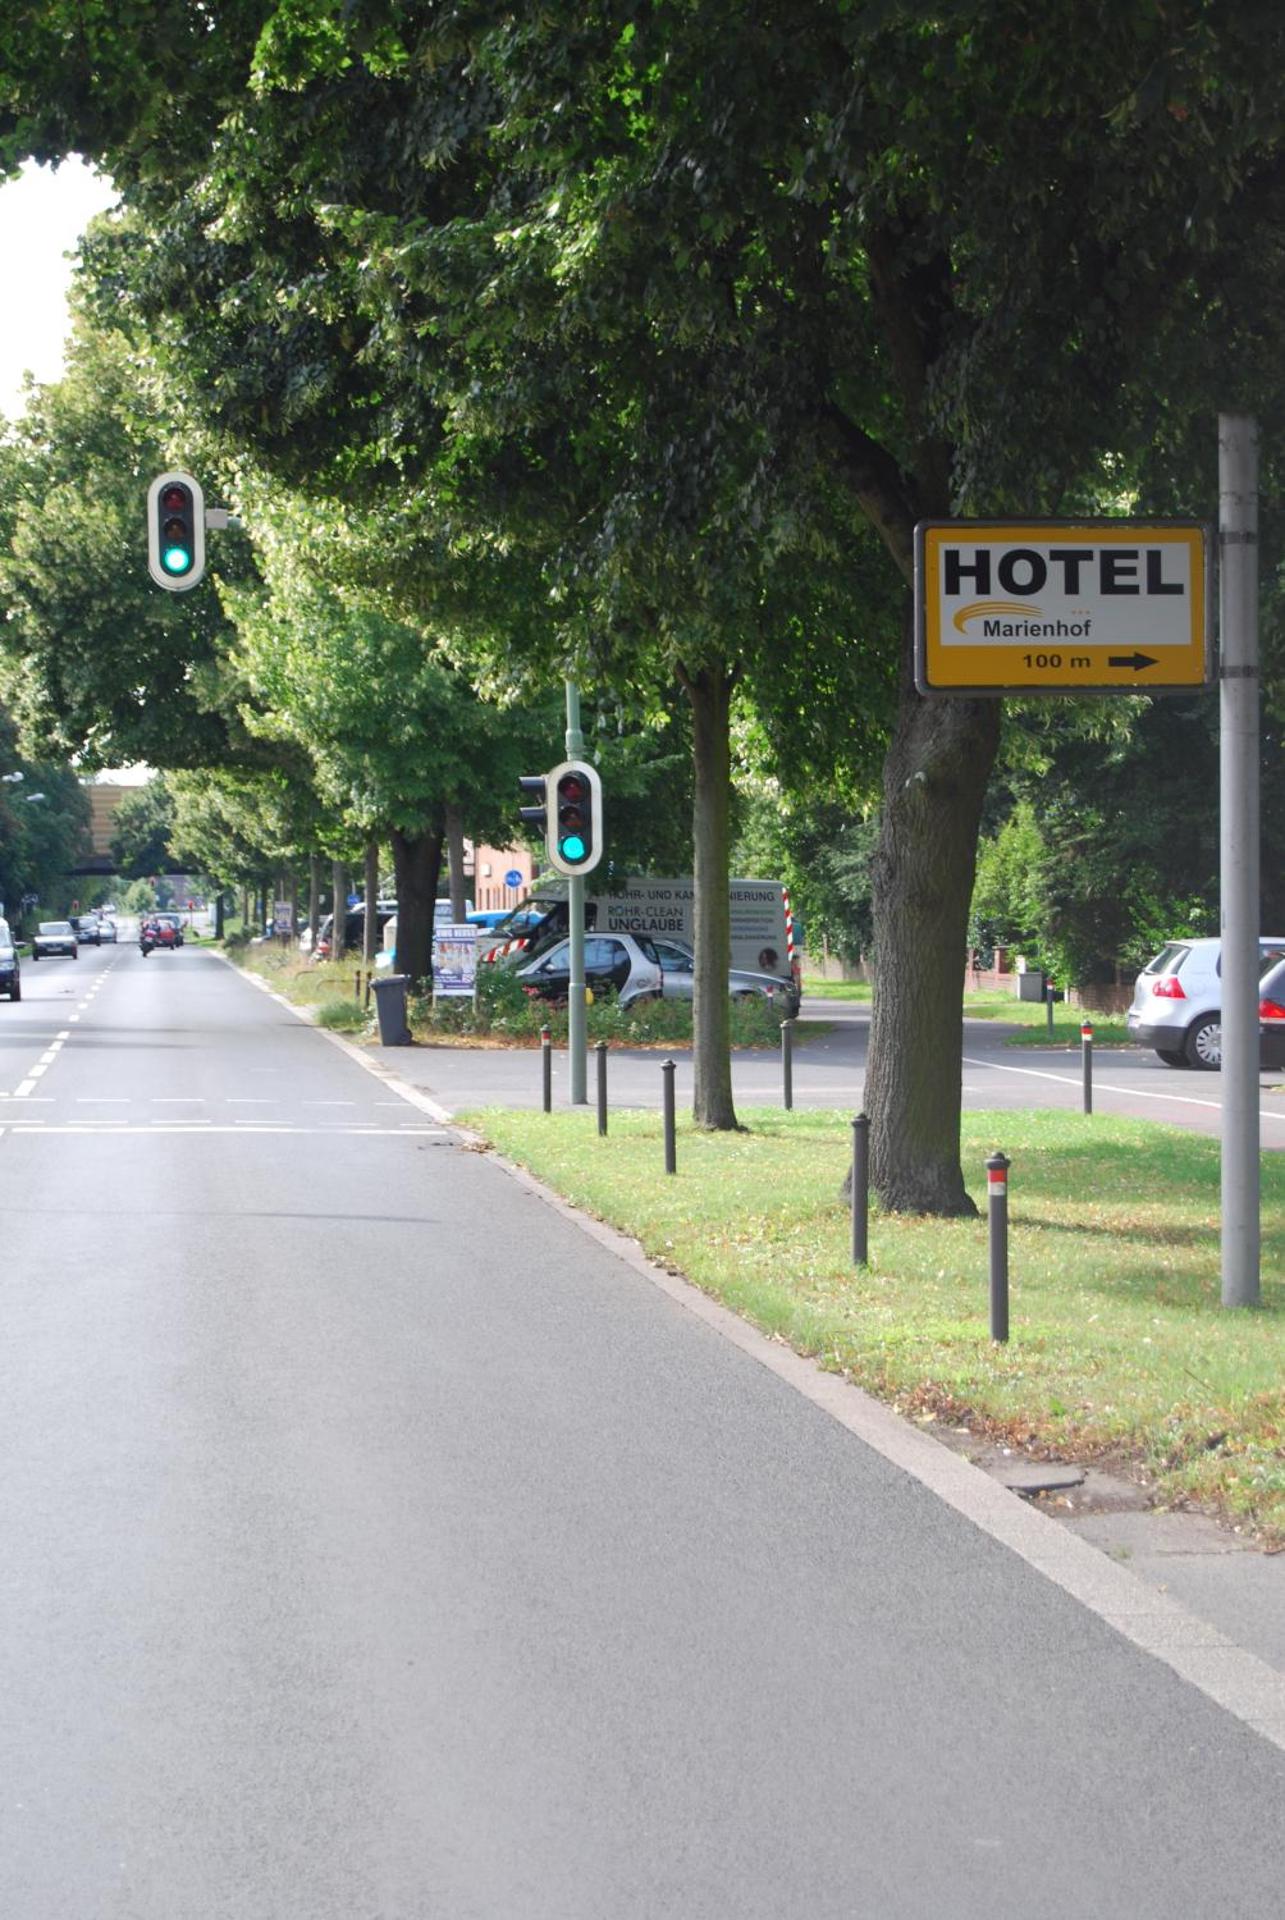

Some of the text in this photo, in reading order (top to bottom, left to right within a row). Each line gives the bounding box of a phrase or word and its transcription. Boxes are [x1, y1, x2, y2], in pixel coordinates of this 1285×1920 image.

[944, 548, 1184, 596] HOTEL
[983, 619, 1092, 638] Marienhof
[1023, 654, 1091, 669] 100 m
[647, 889, 672, 900] UND
[608, 918, 684, 931] UNGLAUBE
